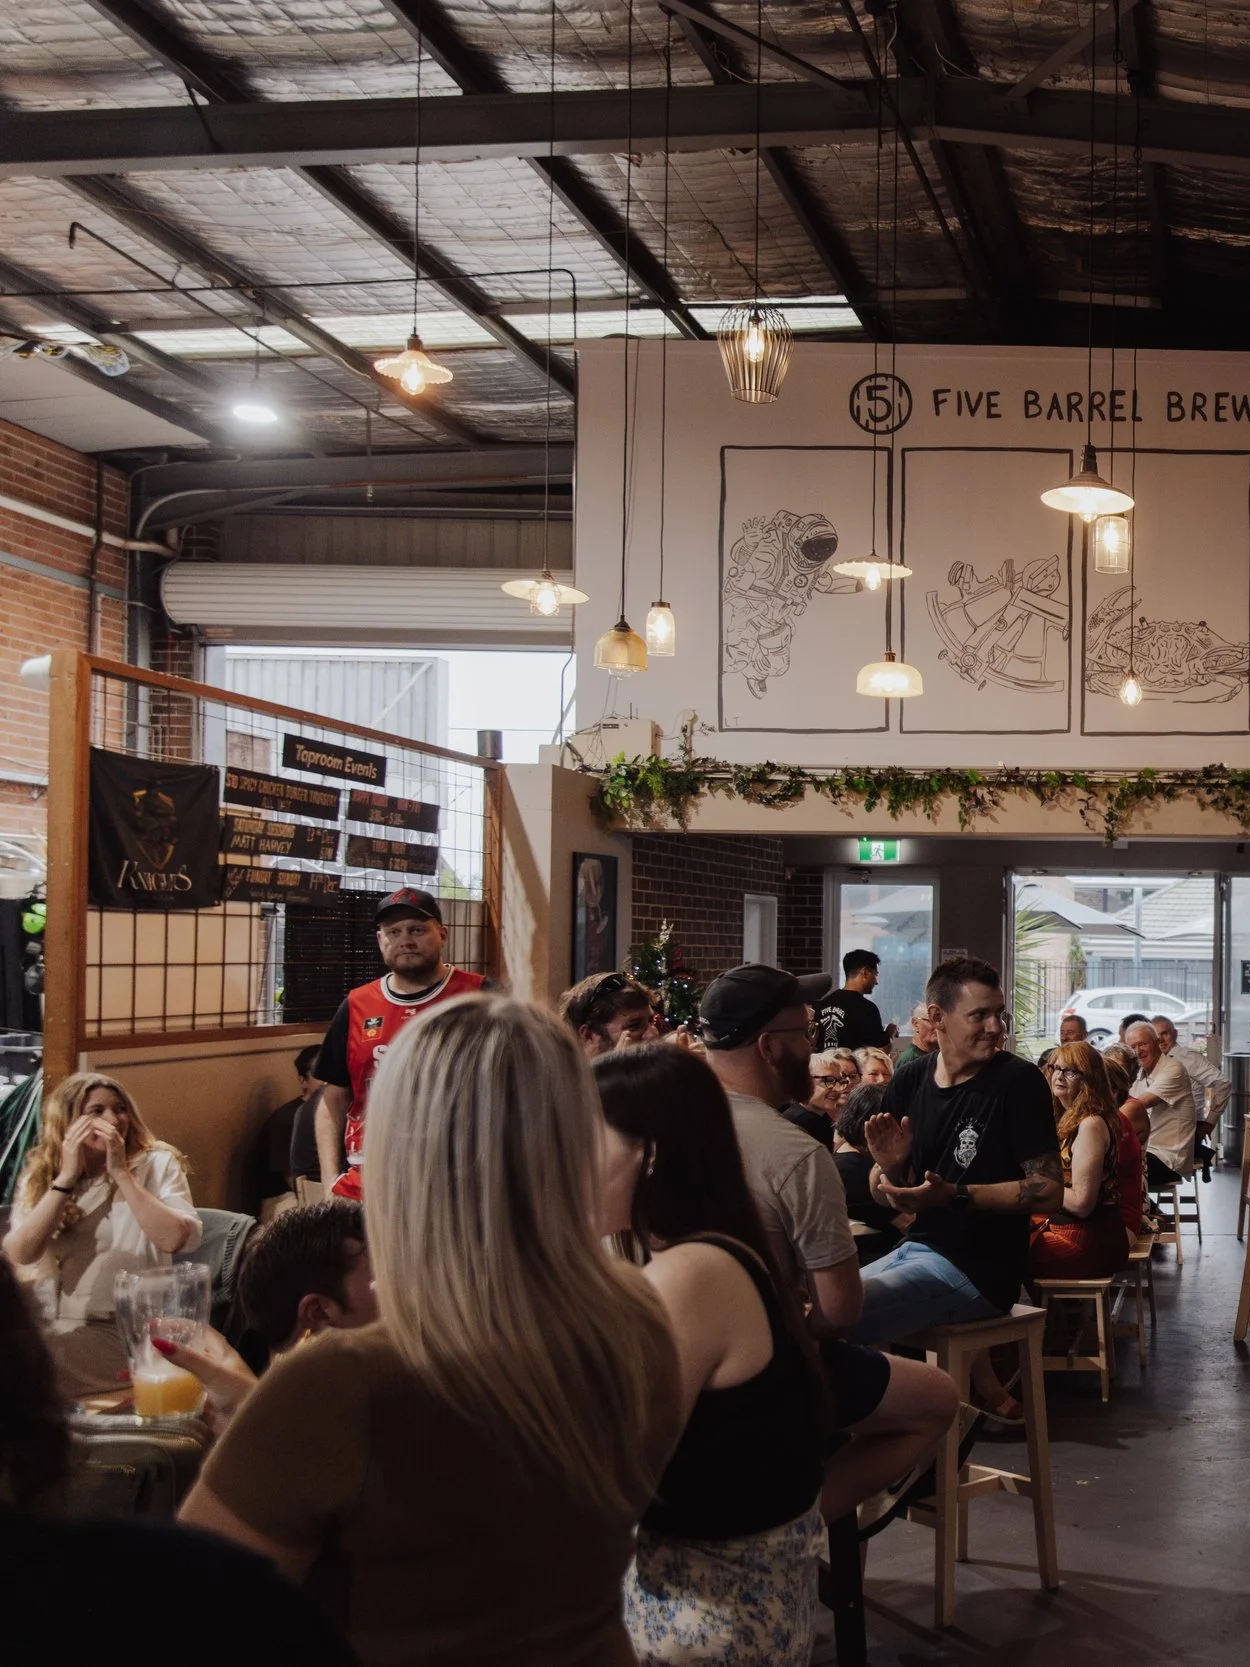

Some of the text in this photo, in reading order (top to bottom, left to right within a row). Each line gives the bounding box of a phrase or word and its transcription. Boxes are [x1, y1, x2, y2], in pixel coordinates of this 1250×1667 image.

[932, 388, 1003, 419] FIVE
[1023, 388, 1143, 423] BARREL
[295, 743, 378, 779] Taproom Events
[239, 775, 258, 793] SPICY
[258, 780, 285, 797] CHICKEN
[230, 834, 293, 854] MATT HARVEY
[821, 1006, 832, 1016] FIVE
